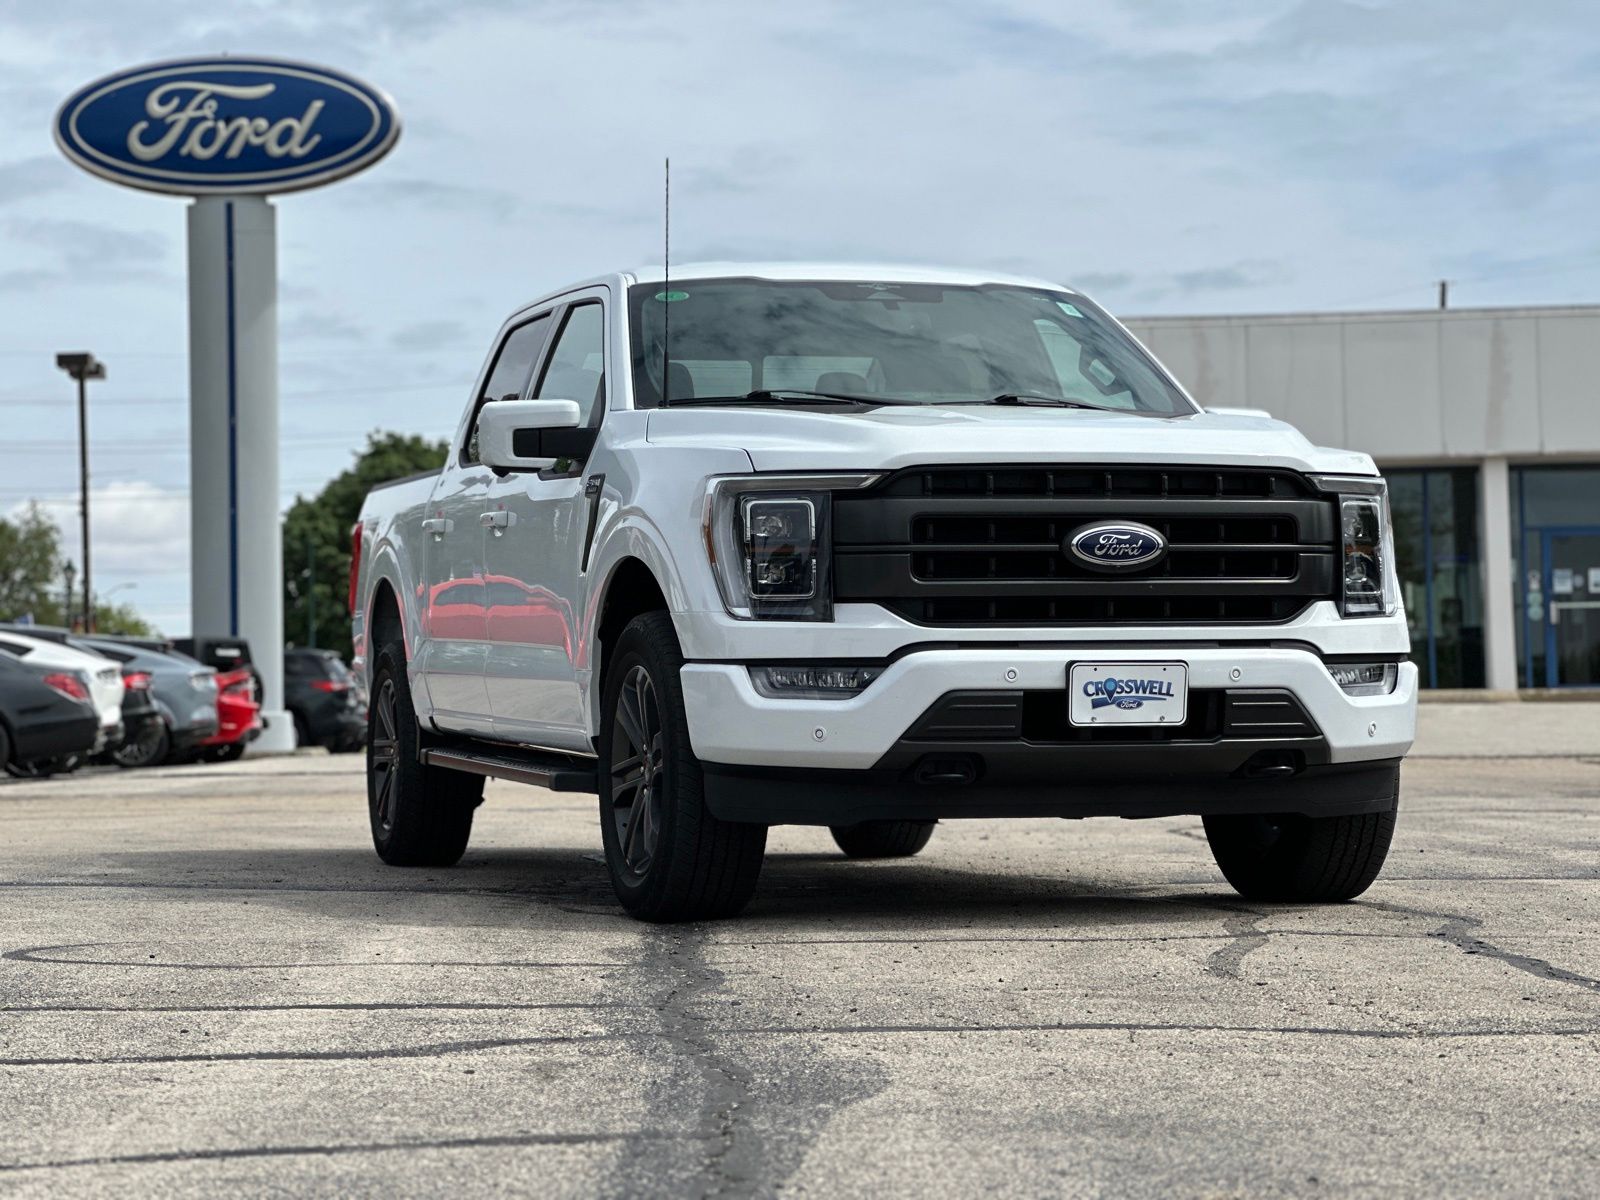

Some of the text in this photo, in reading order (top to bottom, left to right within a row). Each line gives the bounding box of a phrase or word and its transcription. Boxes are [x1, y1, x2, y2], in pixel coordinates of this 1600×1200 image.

[127, 80, 325, 161] Ford
[1094, 533, 1143, 556] Ford
[1082, 677, 1175, 700] CROSSWELL
[1120, 700, 1138, 708] Ford
